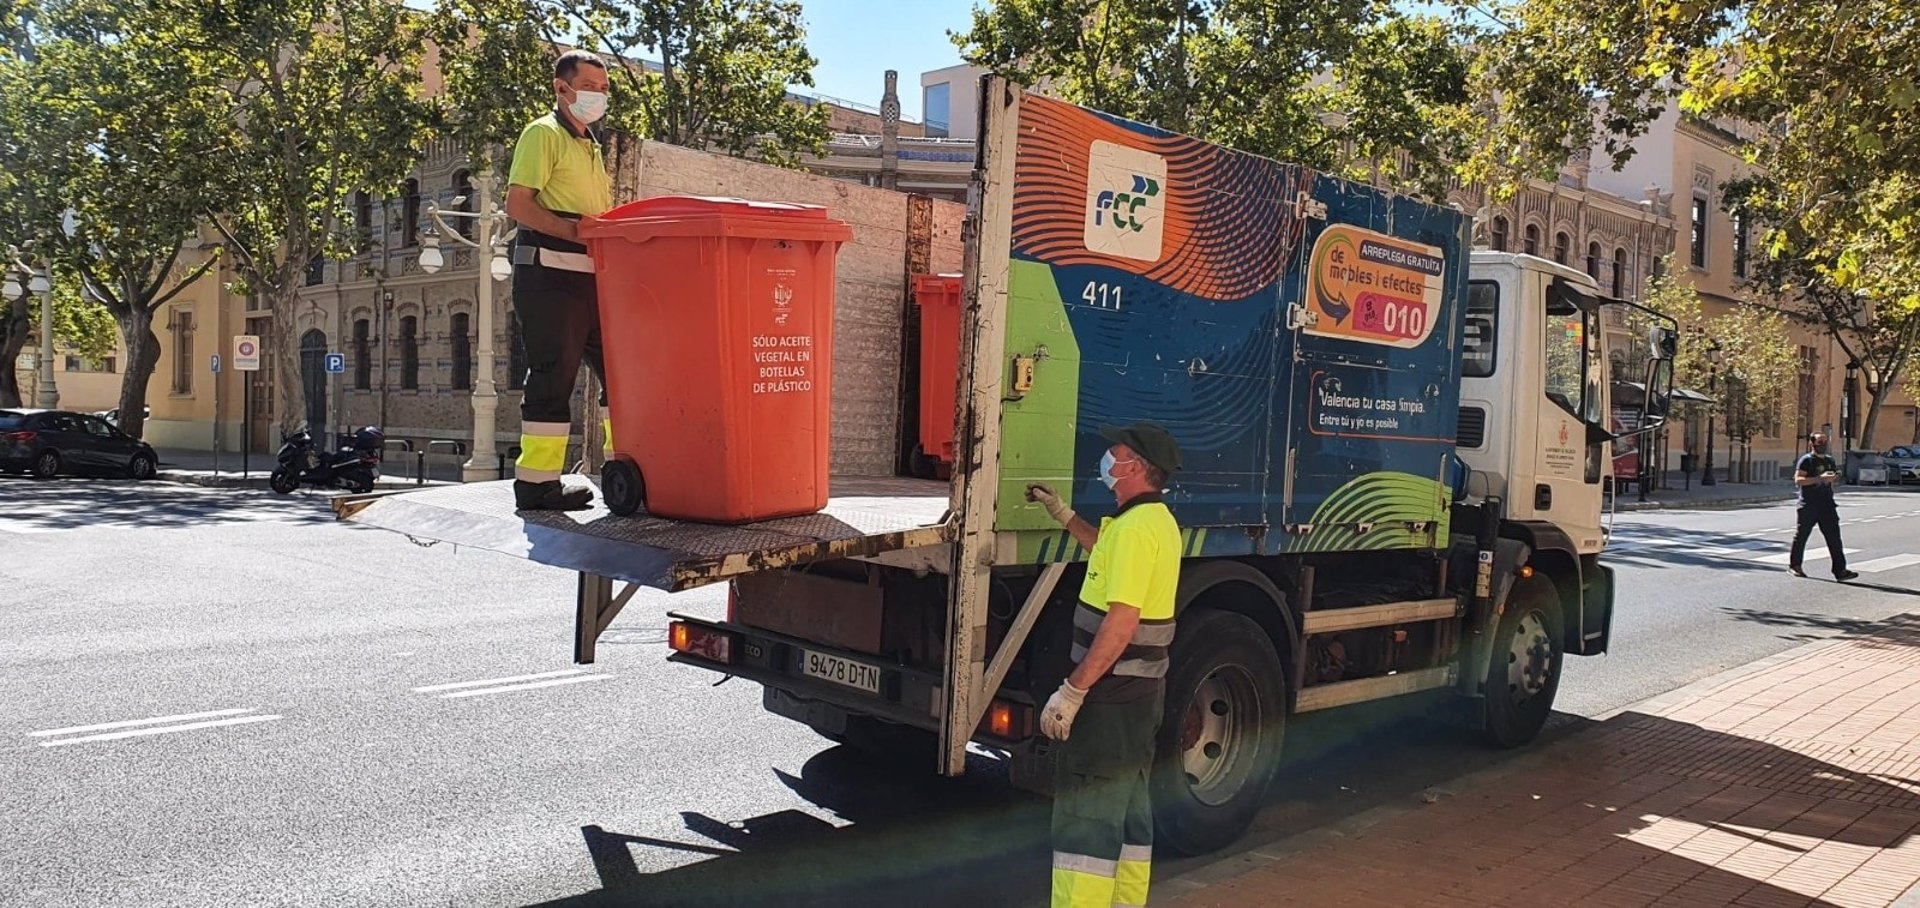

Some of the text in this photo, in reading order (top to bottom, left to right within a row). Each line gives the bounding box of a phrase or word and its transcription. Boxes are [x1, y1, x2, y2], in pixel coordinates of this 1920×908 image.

[1331, 246, 1344, 264] de
[1362, 244, 1405, 264] ARREPLEGA
[1382, 273, 1421, 295] efectes
[1082, 281, 1121, 310] 411
[1384, 302, 1422, 336] 010
[753, 334, 811, 347] SÓLO ACEITE
[330, 357, 340, 370] P
[754, 351, 809, 362] VEGETAL EN
[760, 366, 805, 378] BOTELLAS
[753, 379, 811, 393] DE PLÁSTICO
[1363, 397, 1373, 410] tu
[1375, 400, 1396, 411] casa
[1319, 413, 1340, 426] Entre
[1341, 415, 1350, 426] tú
[1350, 418, 1356, 430] y
[1366, 419, 1375, 428] es
[1375, 417, 1399, 431] posible
[810, 654, 877, 689] 9478 DTN
